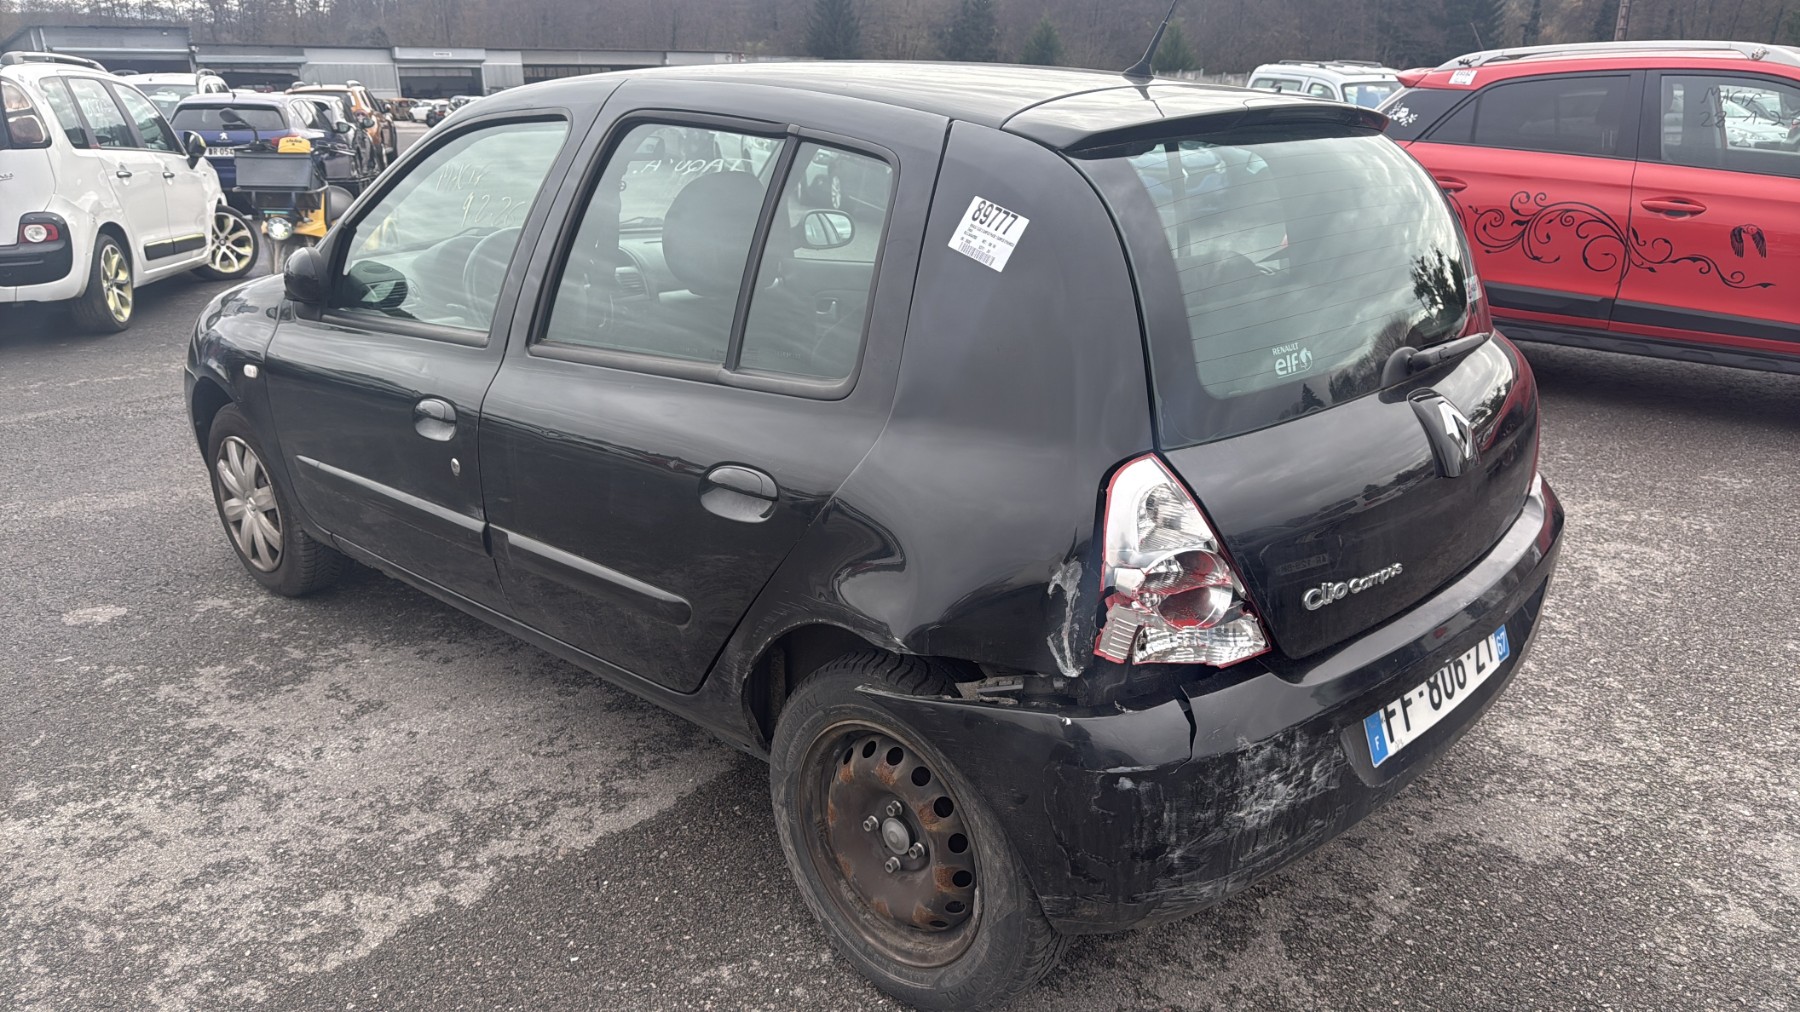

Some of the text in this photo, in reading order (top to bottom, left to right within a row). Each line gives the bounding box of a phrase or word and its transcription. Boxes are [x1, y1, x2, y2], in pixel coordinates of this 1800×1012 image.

[971, 200, 1019, 235] 89777
[1272, 342, 1299, 355] RENAULT
[1275, 352, 1298, 375] elf
[1304, 582, 1348, 611] Clio
[1348, 562, 1403, 594] Campus
[1496, 631, 1507, 656] 67
[1374, 736, 1381, 751] F
